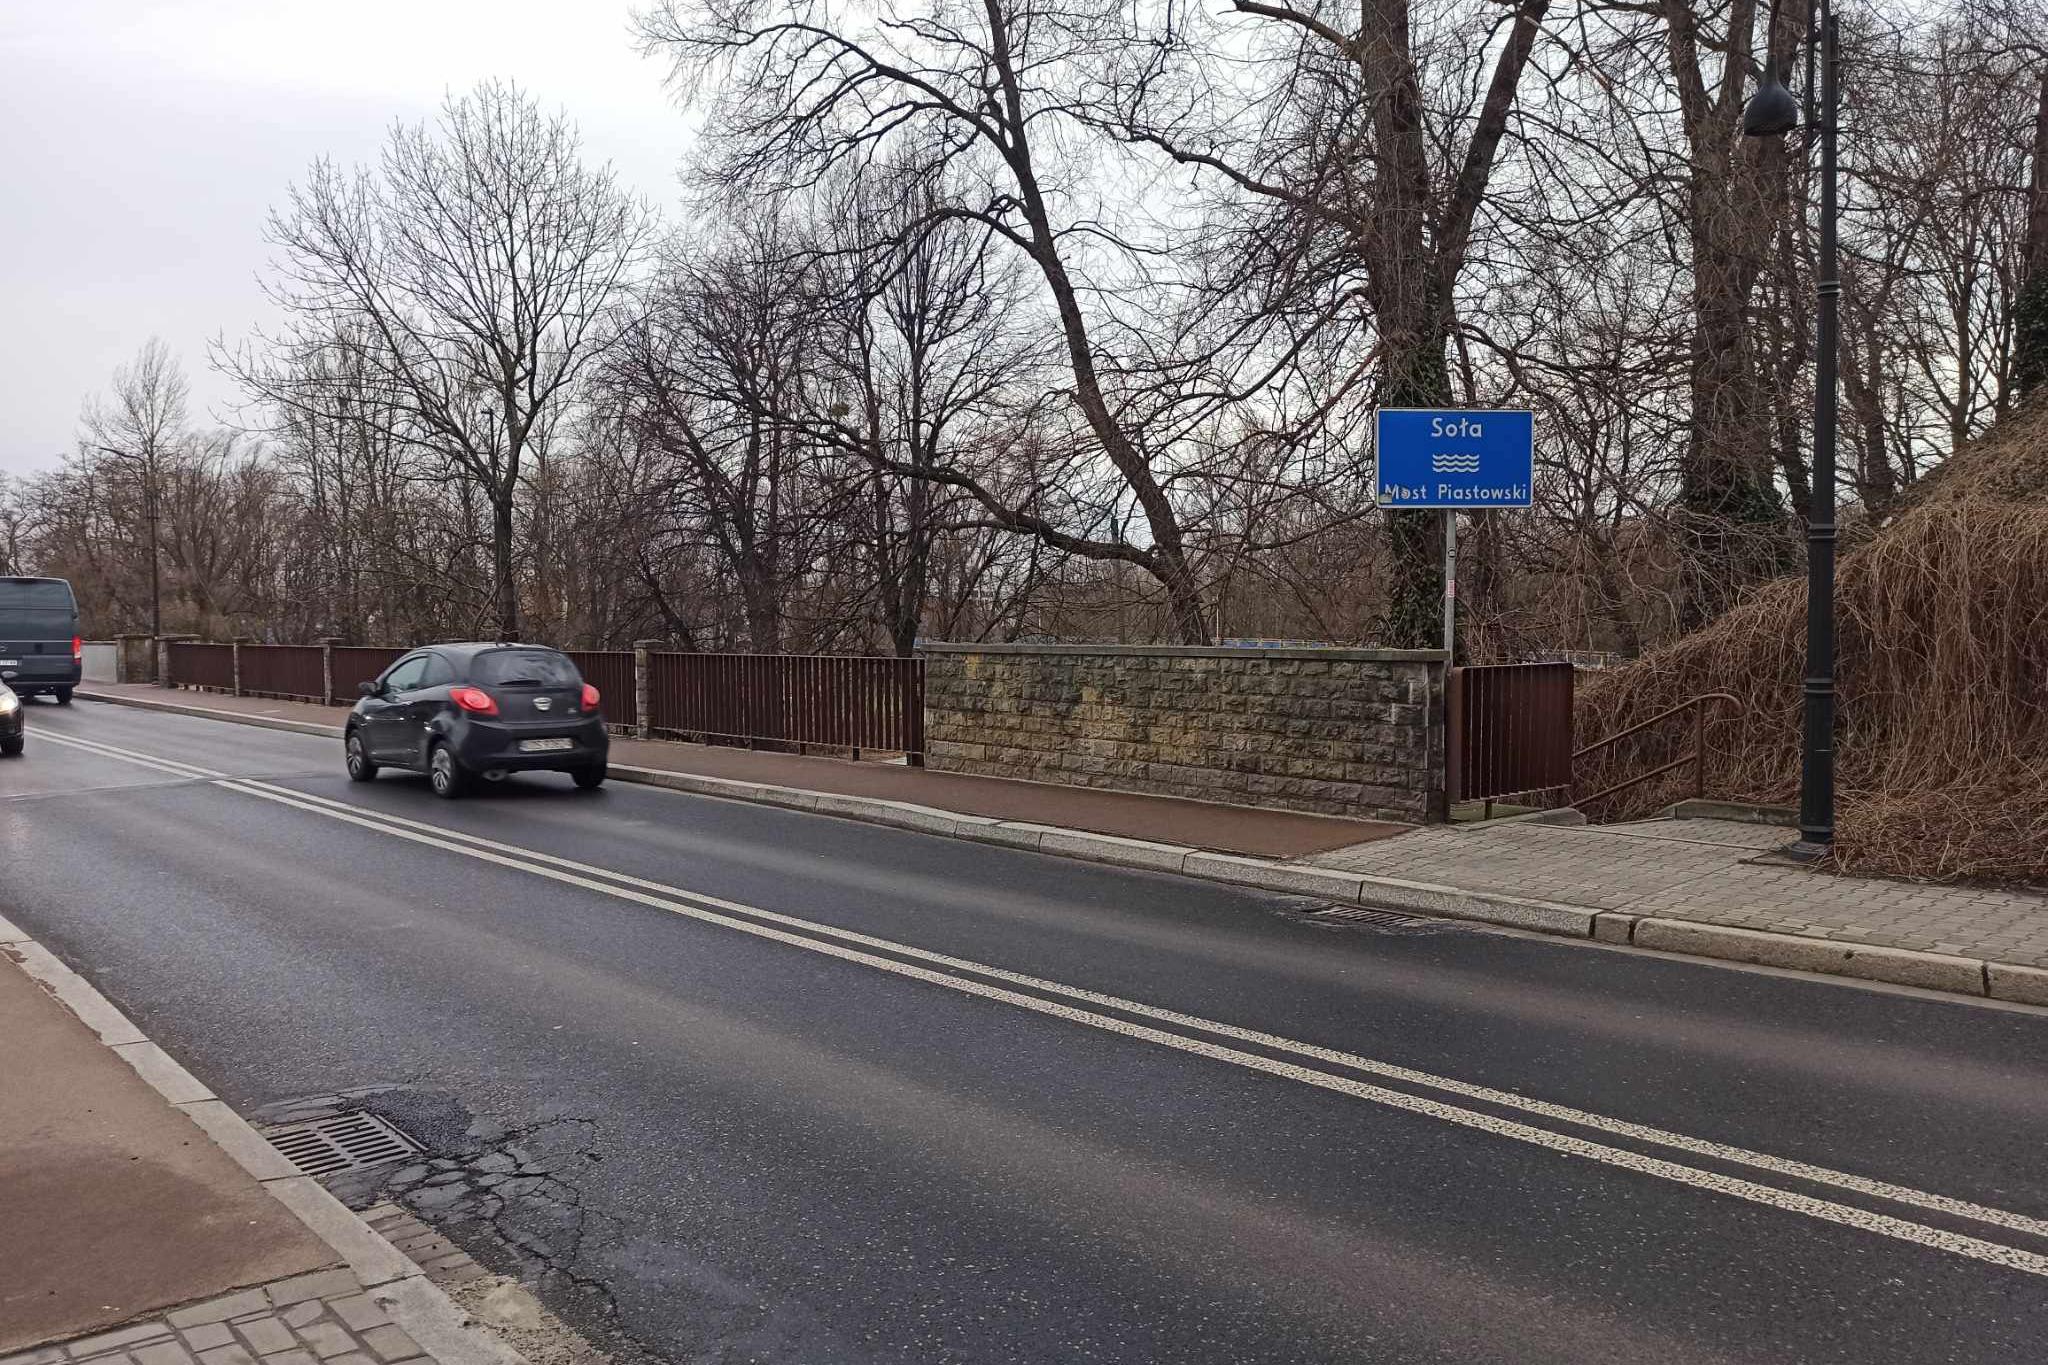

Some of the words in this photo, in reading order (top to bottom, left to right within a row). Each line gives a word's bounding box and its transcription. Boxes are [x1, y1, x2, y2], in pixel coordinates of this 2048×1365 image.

[1431, 417, 1482, 438] Soła
[1384, 483, 1427, 500] Most
[1438, 483, 1527, 500] Piastowski
